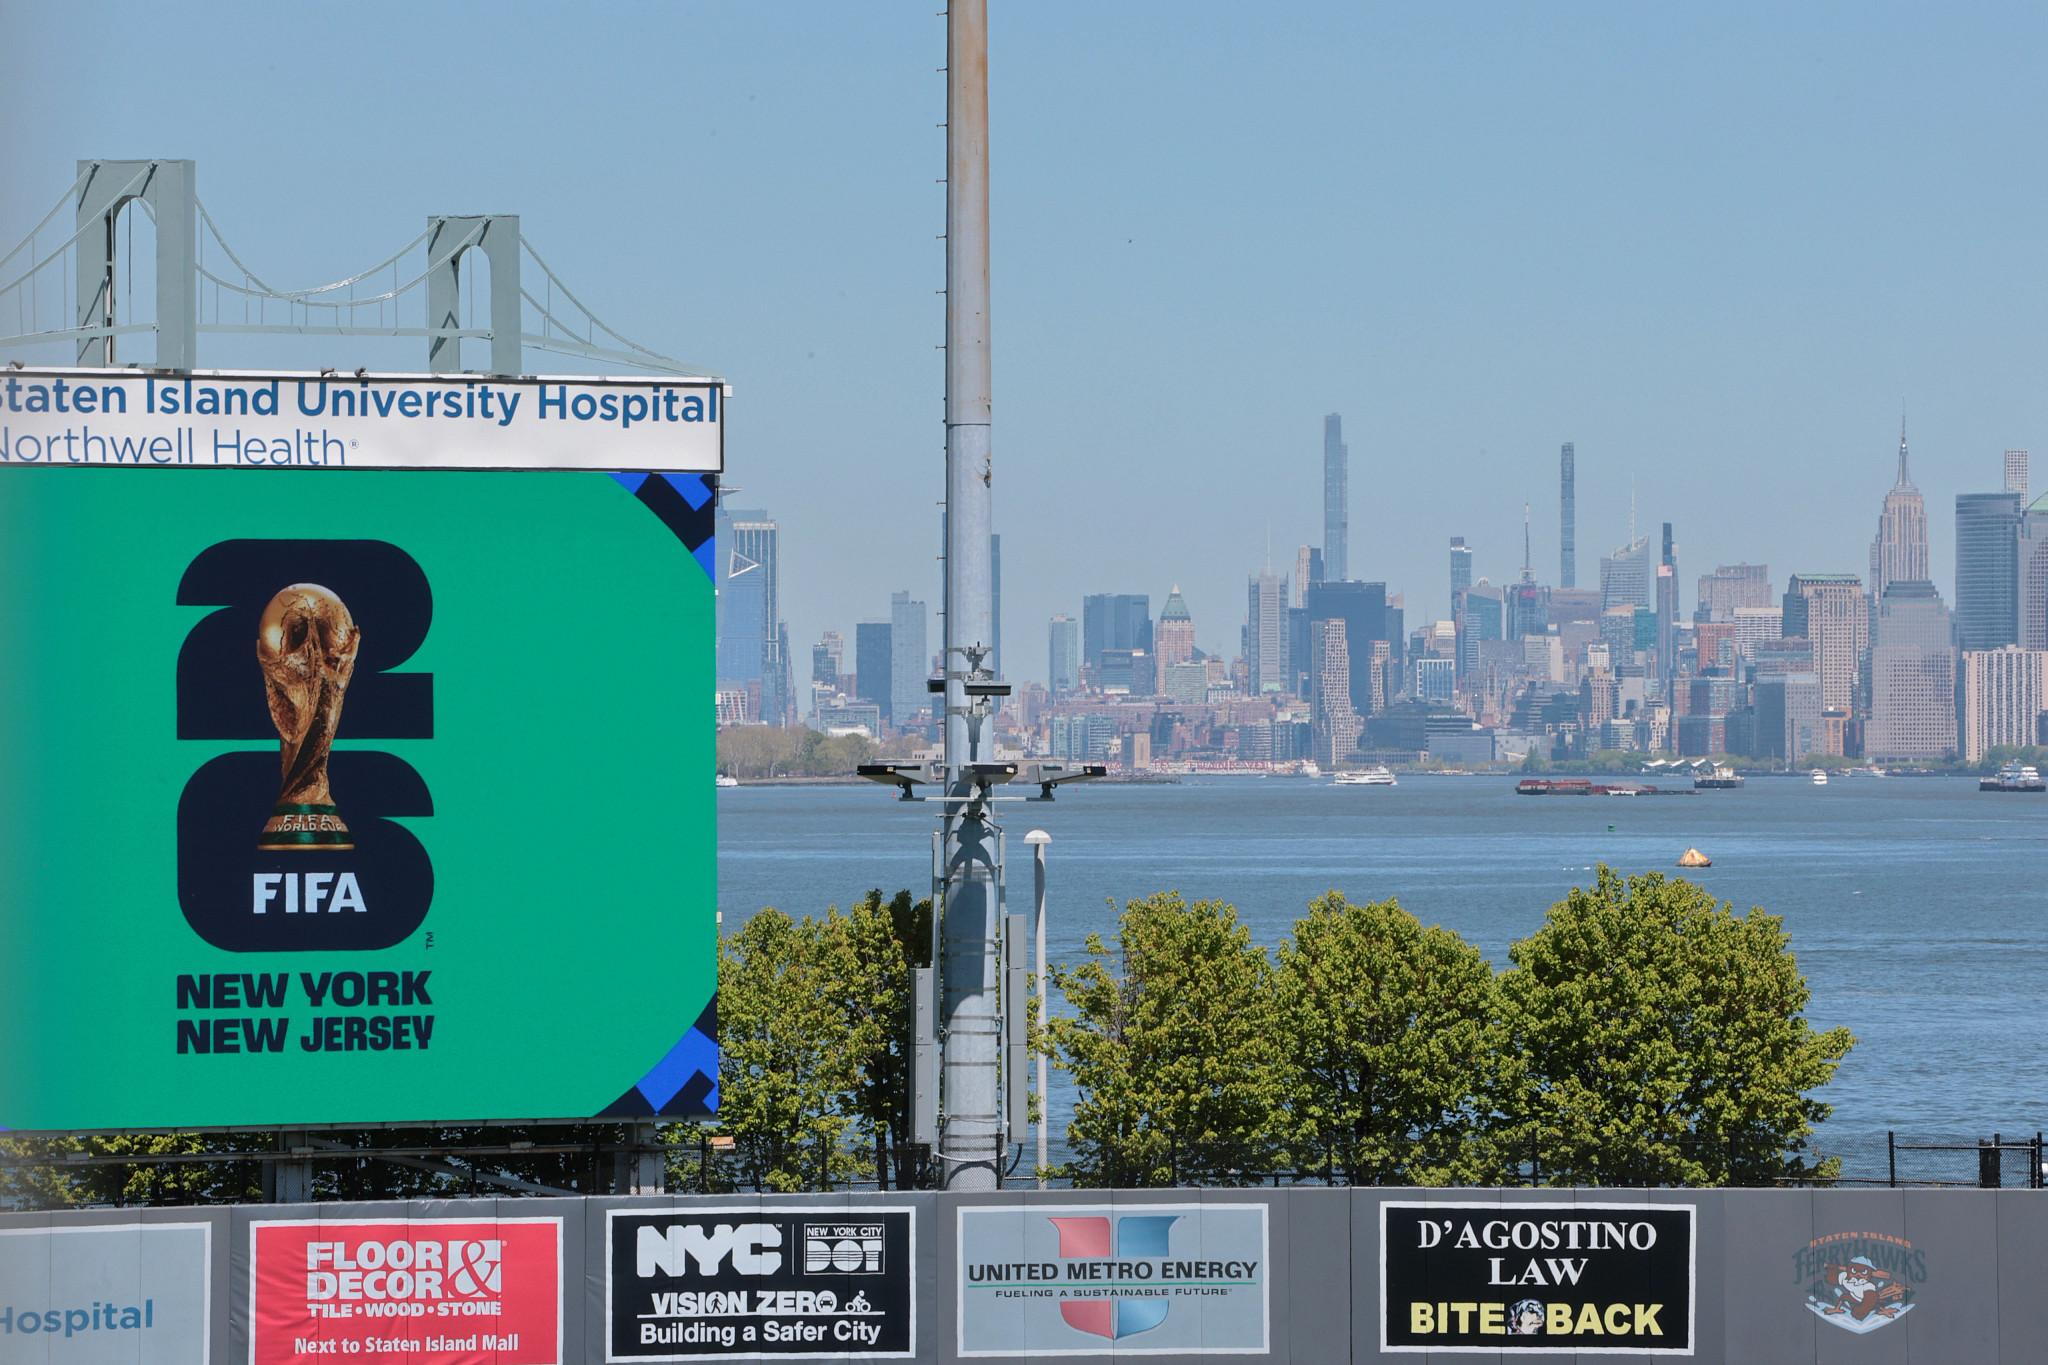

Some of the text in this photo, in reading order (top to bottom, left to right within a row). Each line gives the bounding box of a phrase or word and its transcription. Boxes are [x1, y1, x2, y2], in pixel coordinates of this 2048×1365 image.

[0, 376, 717, 428] taten Island University Hospital
[274, 823, 317, 831] WORLD
[283, 814, 333, 823] FIFA
[253, 872, 368, 914] FIFA
[177, 970, 432, 1009] NEW YORK
[177, 1015, 435, 1054] NEW JERSEY
[806, 1227, 882, 1236] NEW YORK CITY
[1417, 1220, 1657, 1250] D'AGOSTINO
[306, 1241, 443, 1270] FLOOR
[637, 1223, 782, 1278] NYC
[806, 1240, 882, 1272] DOT
[306, 1270, 443, 1300] DECOR
[968, 1261, 1258, 1281] UNITED METRO ENERGY
[1487, 1257, 1589, 1286] LAW
[651, 1290, 838, 1315] VISION ZERO
[995, 1289, 1054, 1298] FUELING
[1059, 1289, 1068, 1297] A
[1073, 1288, 1169, 1297] SUSTAINABLE
[437, 1301, 502, 1316] STONE
[1410, 1302, 1664, 1336] BITE BACK
[295, 1334, 519, 1354] Next to Staten Island Mall
[640, 1320, 881, 1347] Building a Safer City
